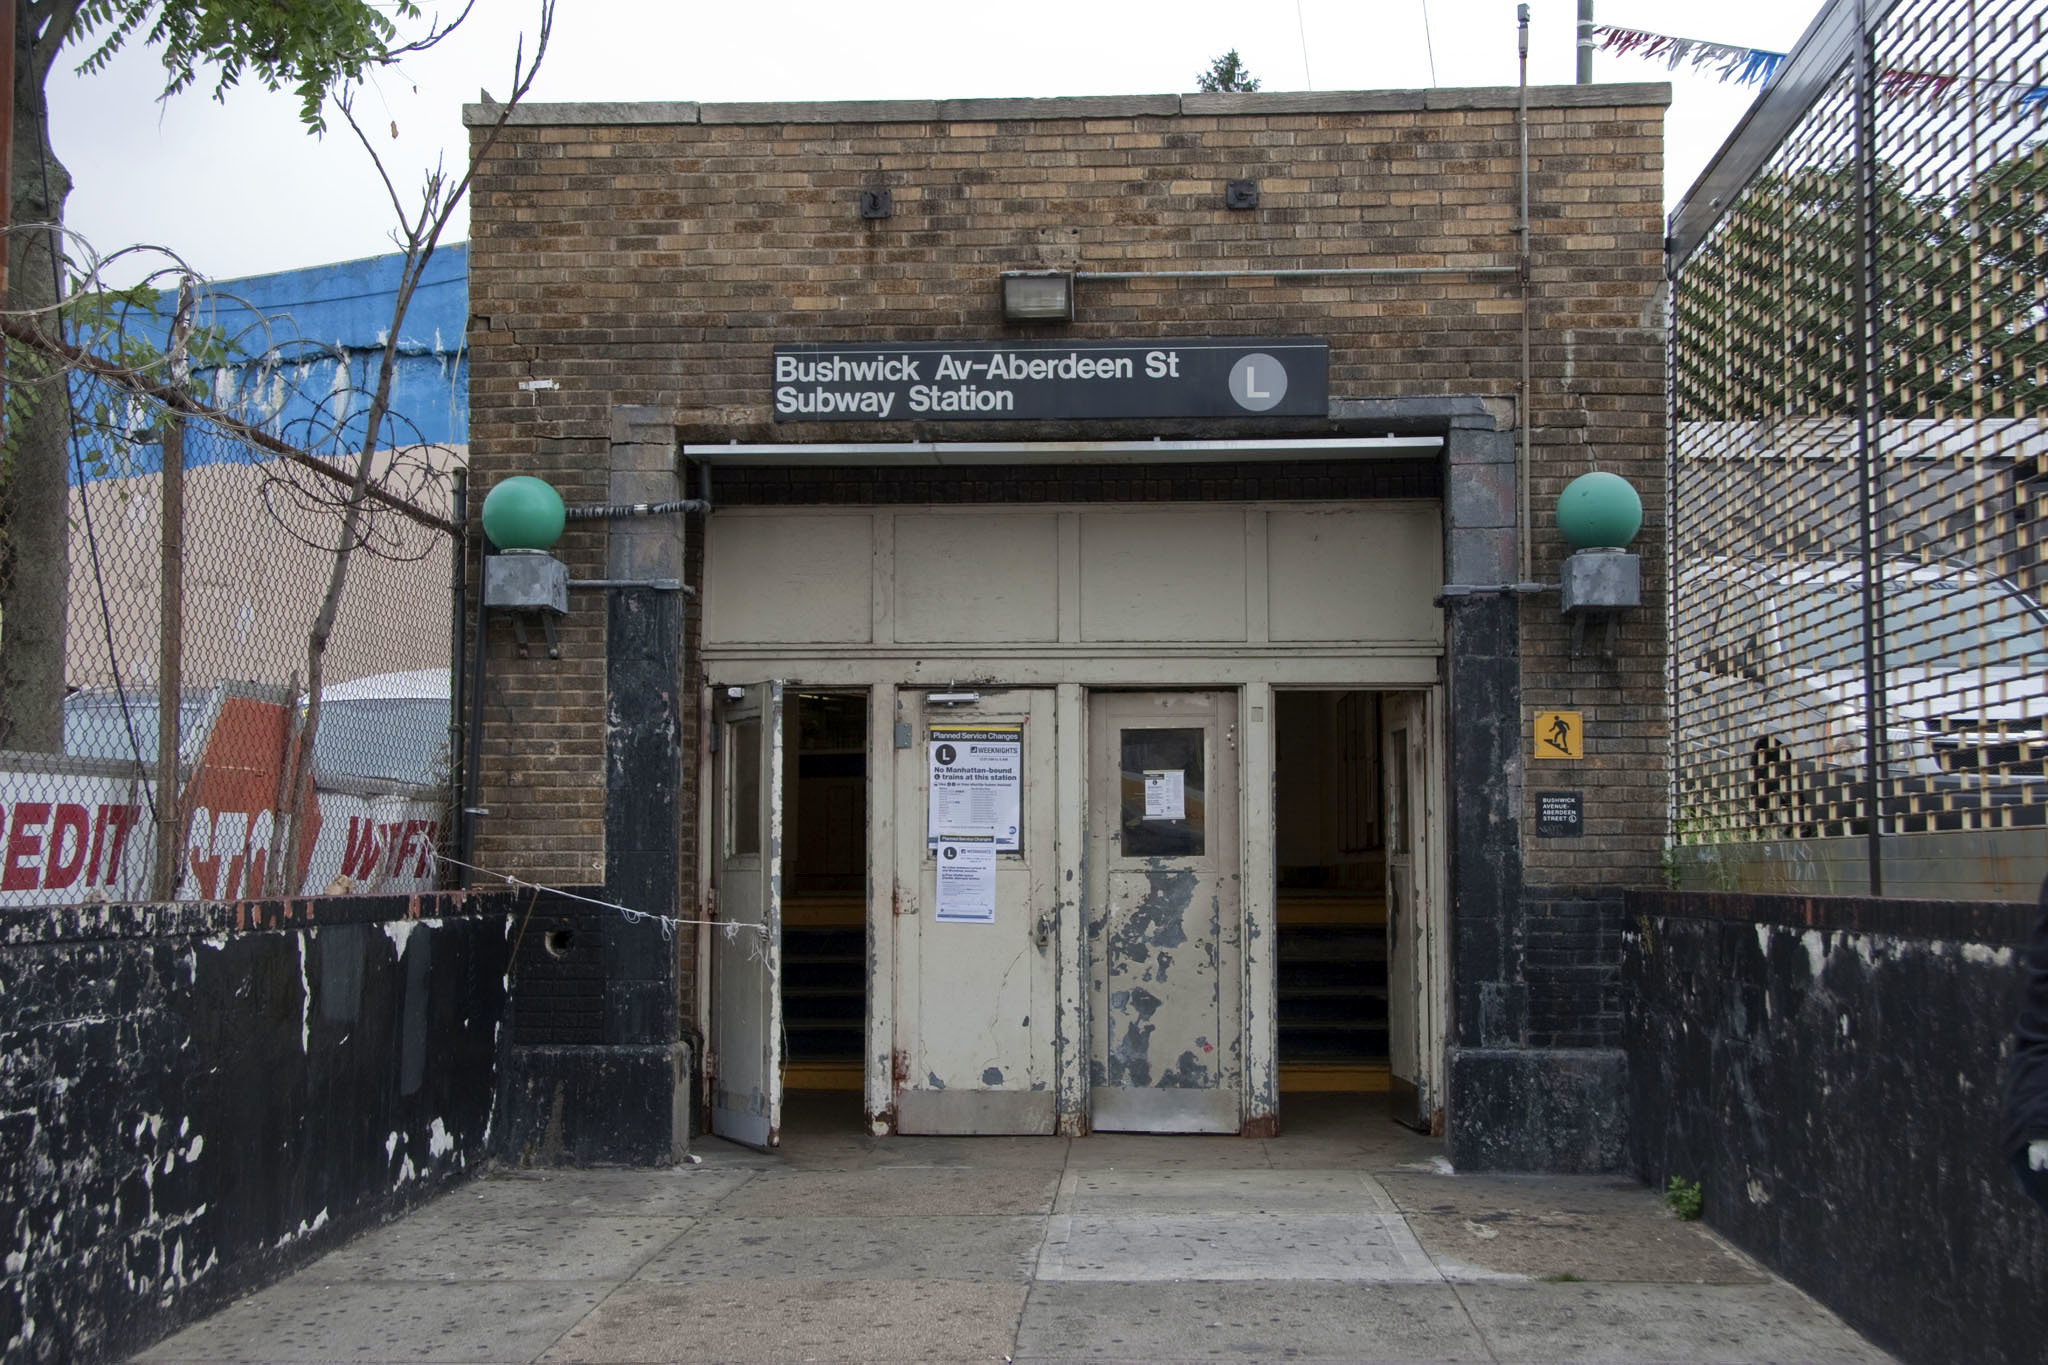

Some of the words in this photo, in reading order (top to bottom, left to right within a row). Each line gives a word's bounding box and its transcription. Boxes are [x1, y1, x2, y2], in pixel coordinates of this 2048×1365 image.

[776, 355, 920, 382] Bushwick
[1145, 351, 1180, 378] St
[1246, 366, 1270, 399] L
[776, 386, 895, 418] Subway
[908, 384, 1014, 412] Station
[988, 732, 1018, 741] Changes
